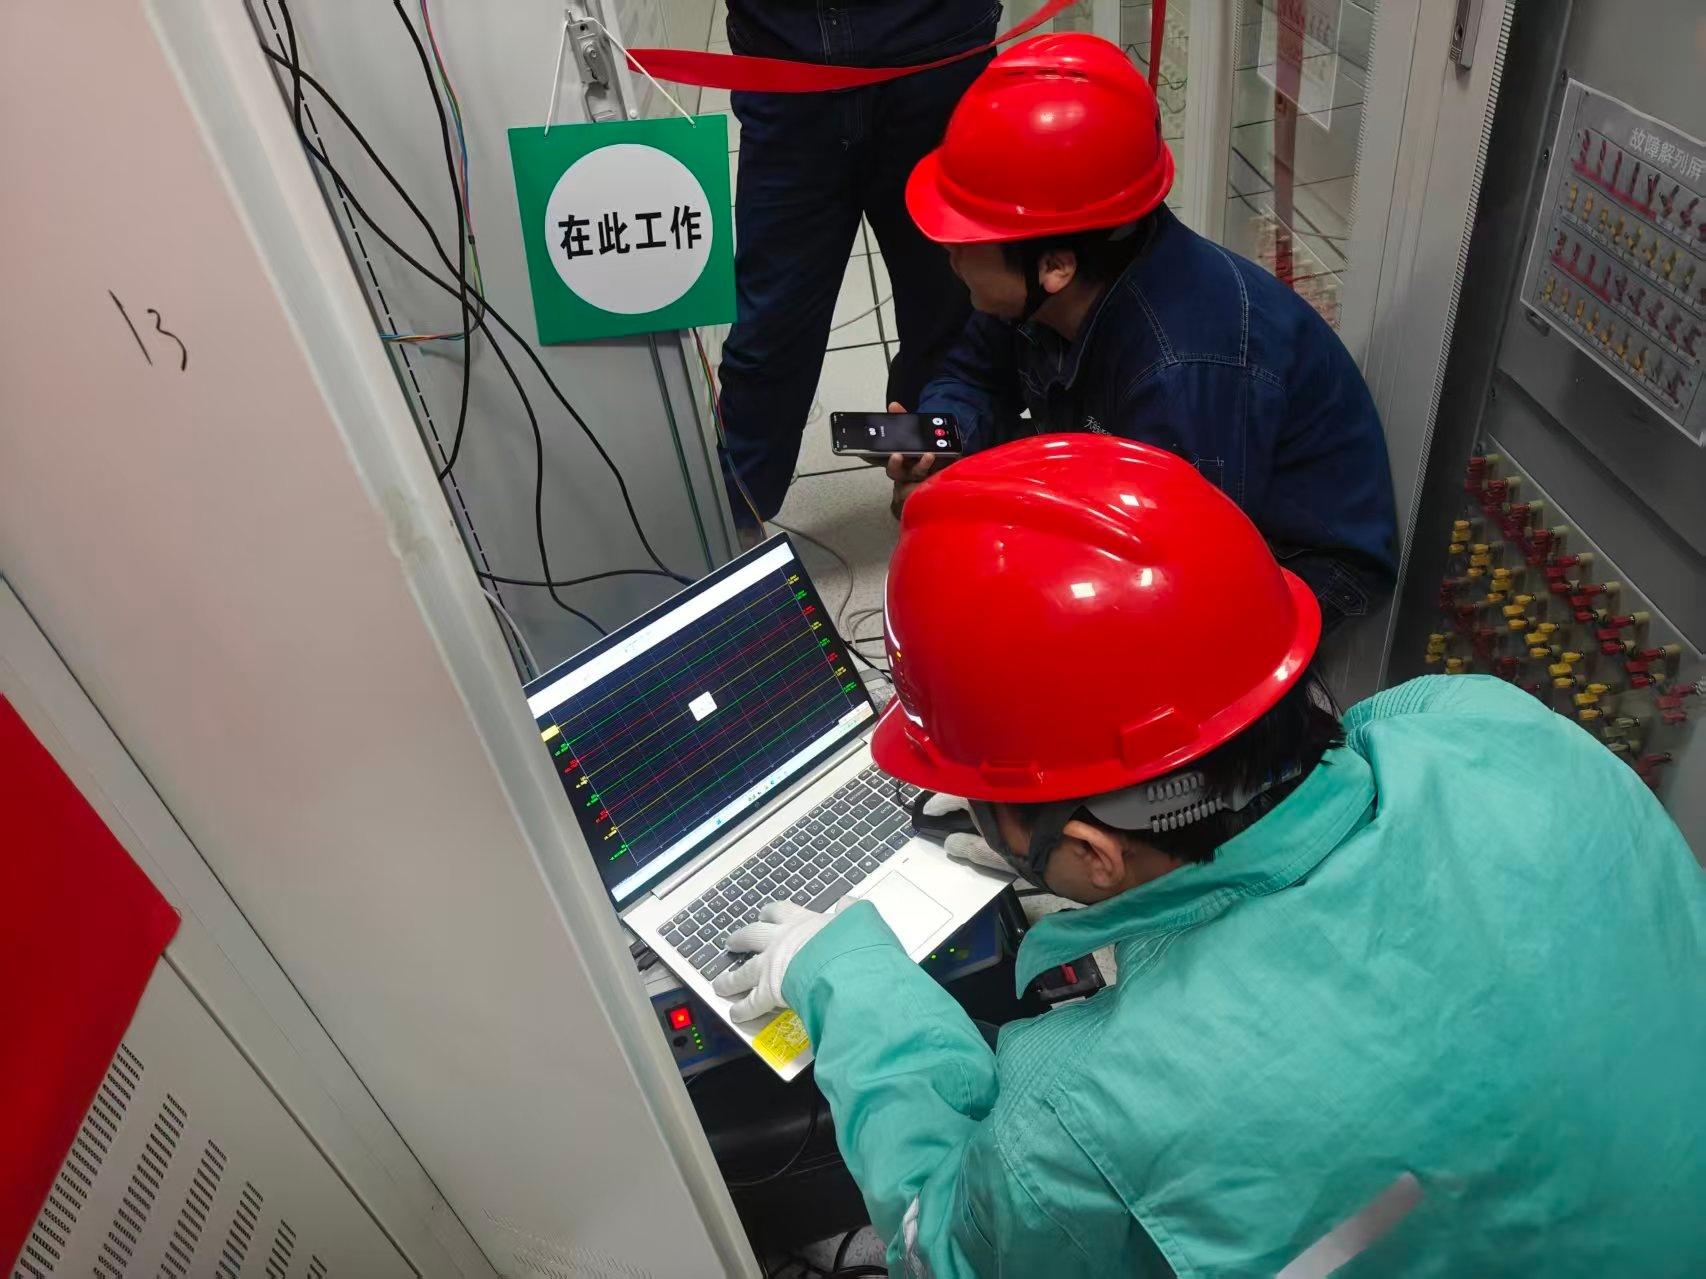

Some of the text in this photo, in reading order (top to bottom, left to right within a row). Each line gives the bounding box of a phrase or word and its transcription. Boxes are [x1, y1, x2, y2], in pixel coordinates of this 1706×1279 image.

[558, 205, 702, 260] 在此工作
[108, 289, 187, 371] 13
